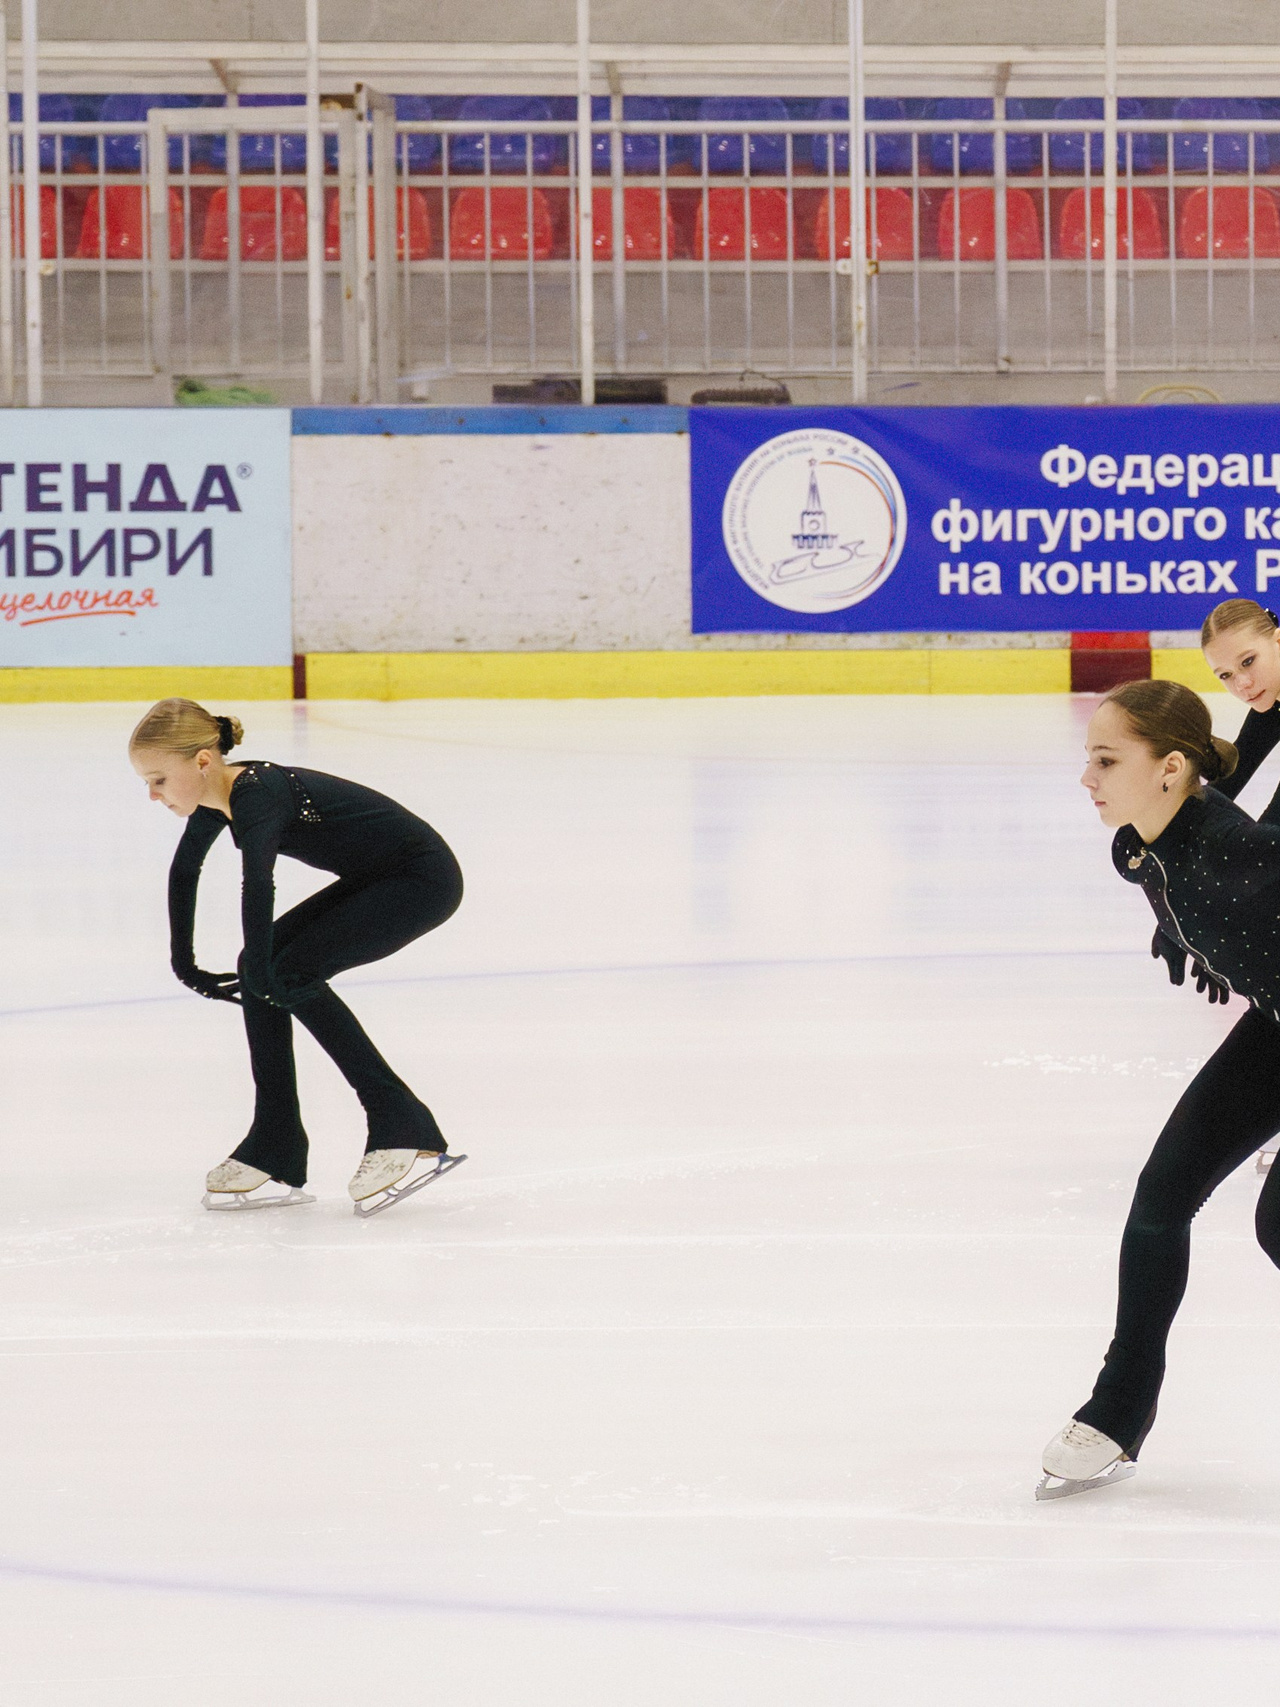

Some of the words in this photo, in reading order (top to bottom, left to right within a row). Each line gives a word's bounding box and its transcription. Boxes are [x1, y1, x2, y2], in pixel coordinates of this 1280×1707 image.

[931, 498, 1227, 553] фигурного
[939, 561, 1002, 595] на
[1019, 560, 1239, 595] коньках
